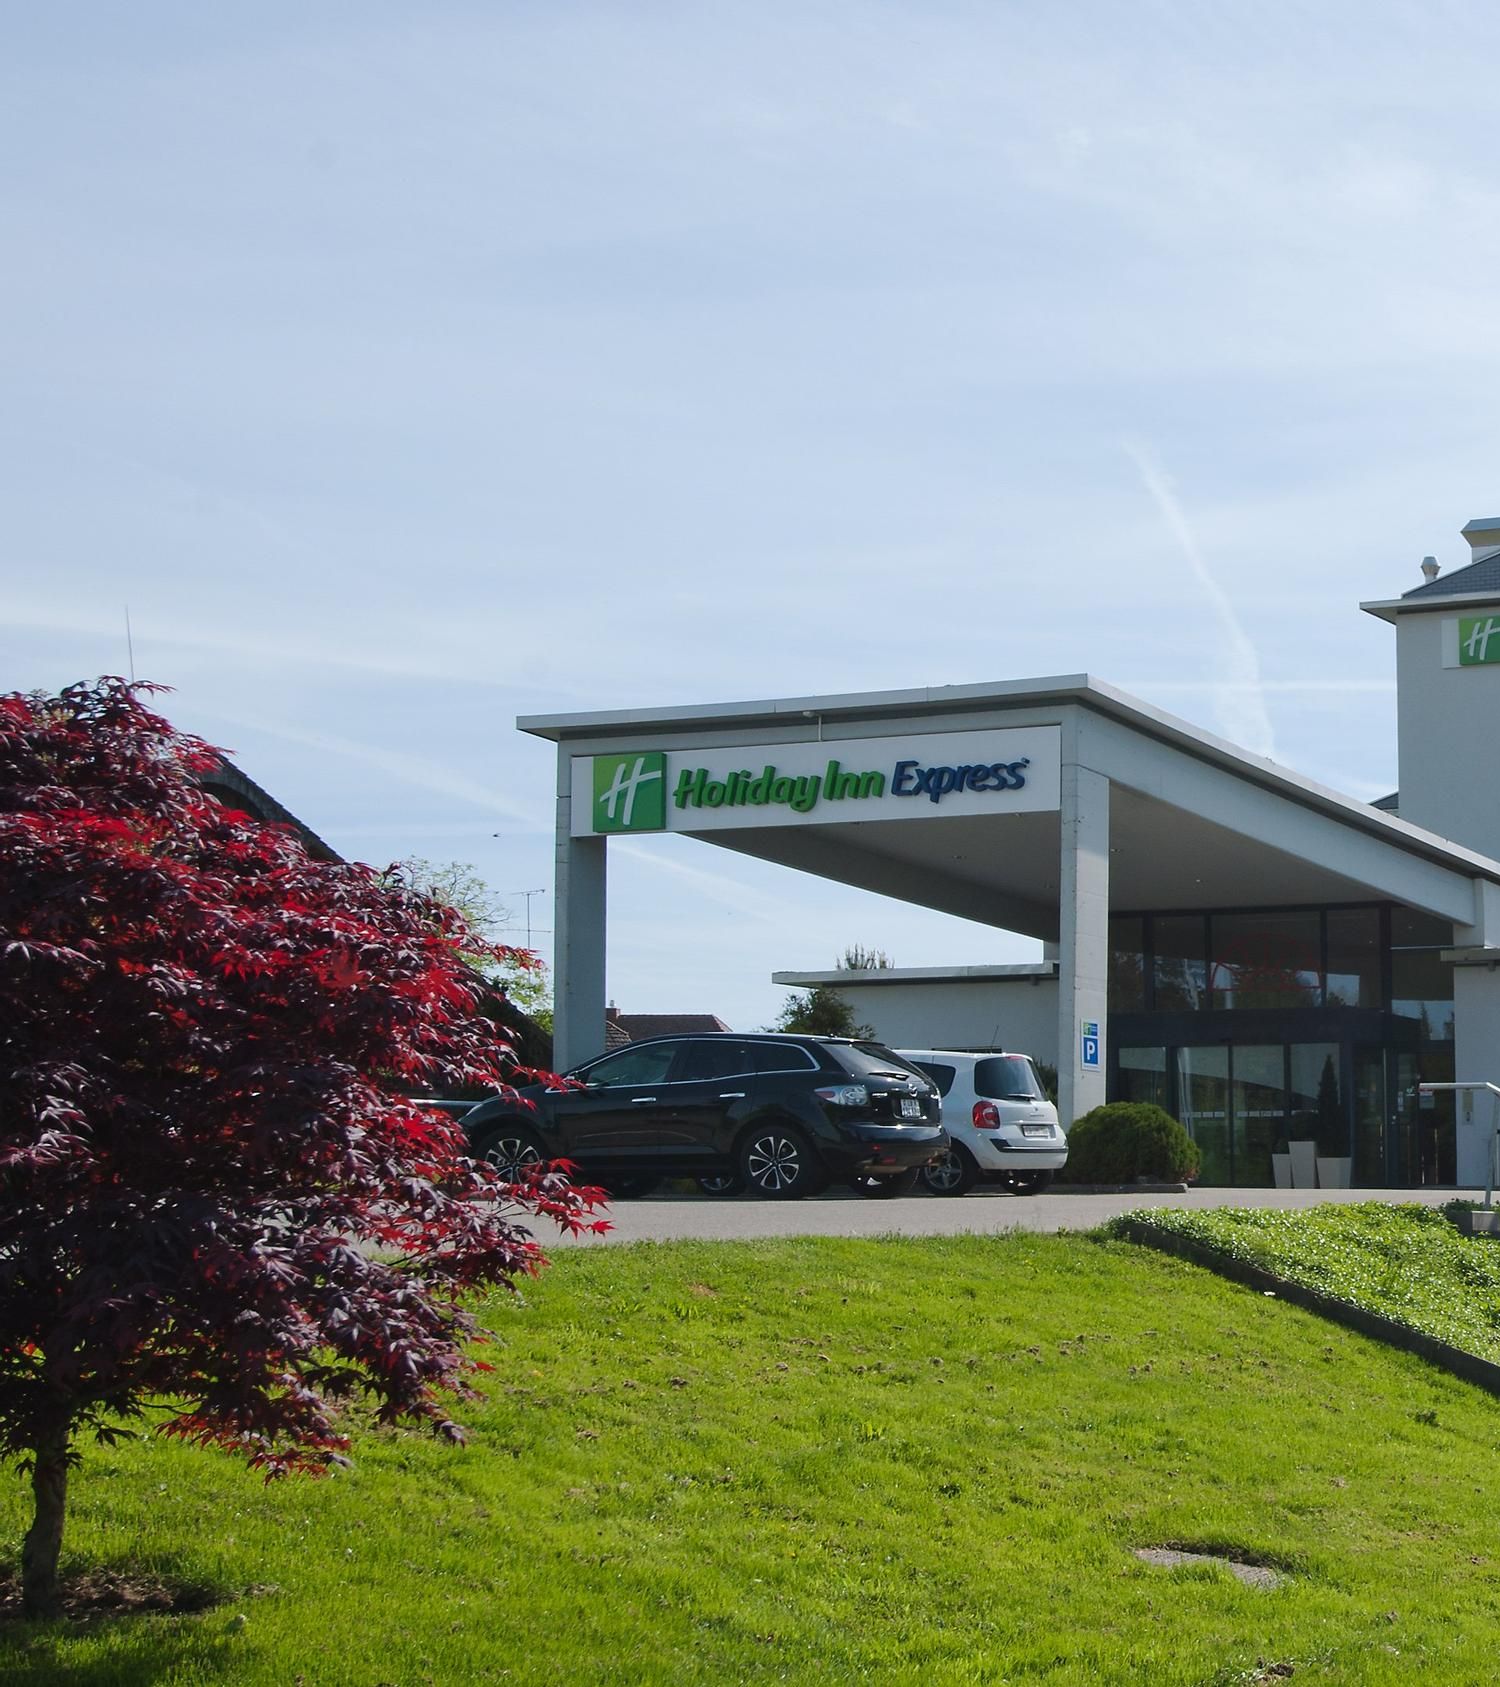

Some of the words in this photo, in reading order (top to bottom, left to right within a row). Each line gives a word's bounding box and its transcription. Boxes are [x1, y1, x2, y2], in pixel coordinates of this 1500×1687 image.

[673, 766, 821, 812] Holiday
[823, 760, 884, 800] Inn
[891, 758, 1029, 803] Express
[1087, 1041, 1095, 1060] P
